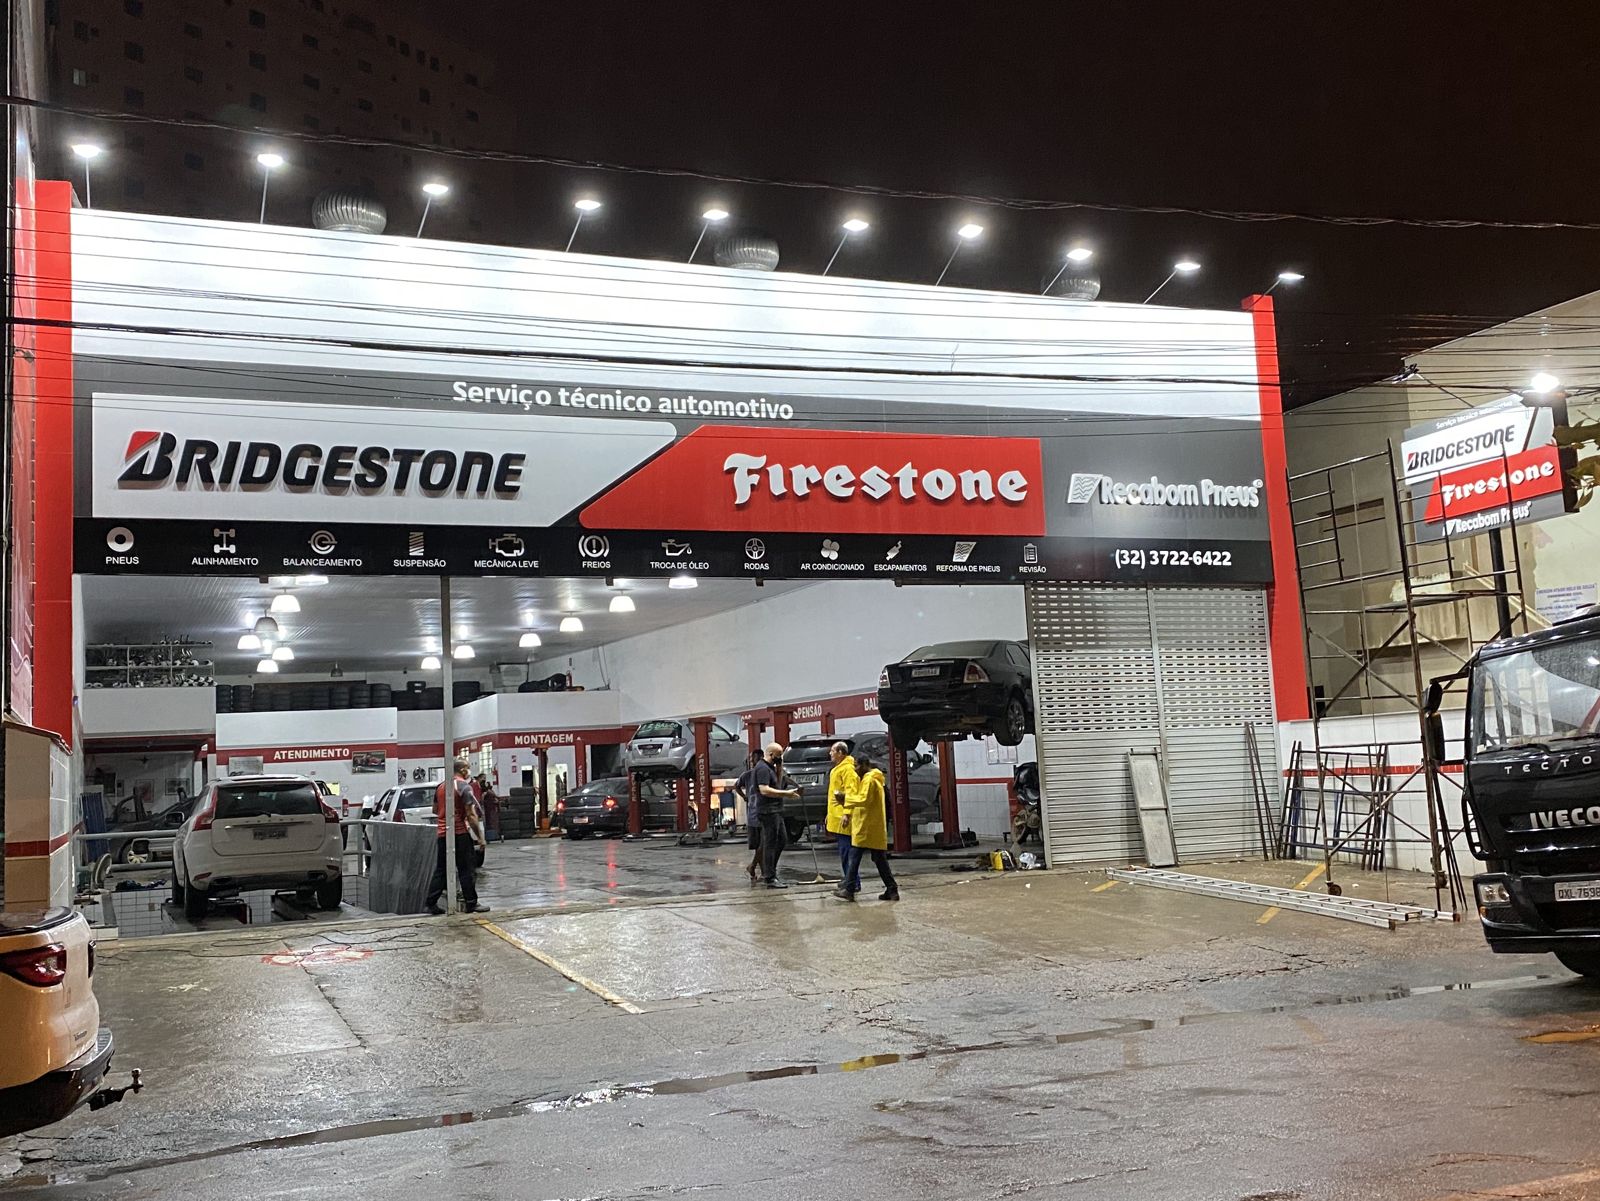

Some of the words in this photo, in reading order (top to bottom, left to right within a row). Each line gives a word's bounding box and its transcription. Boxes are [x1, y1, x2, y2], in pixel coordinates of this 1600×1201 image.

[452, 381, 552, 410] Serviço
[558, 387, 652, 413] técnico
[658, 394, 794, 420] automotivo
[1407, 425, 1515, 472] BRIDGESTONE
[117, 430, 527, 497] BRIDGESTONE
[723, 452, 1028, 505] Firestone
[1441, 461, 1555, 507] Firestone
[1100, 475, 1199, 507] Recabom
[105, 556, 140, 565] PNEUS
[191, 556, 259, 566] ALINHAMENTO
[283, 557, 363, 567] BALANCEAMENTO
[393, 557, 447, 568] SUSPENSÃO
[474, 557, 517, 568] MECÂNICA
[518, 559, 539, 568] LEVE
[582, 560, 611, 569] FREIOS
[650, 561, 676, 570] TROCA
[677, 561, 687, 570] DE
[688, 559, 710, 570] ÓLEO
[1115, 548, 1147, 570] (32)
[1149, 550, 1232, 566] 3722-6422
[744, 562, 770, 570] RODAS
[812, 563, 865, 571] CONDICIONADO
[874, 563, 927, 572] ESCAPAMENTOS
[936, 564, 968, 572] REFORMA
[979, 565, 1001, 573] PNEUS
[1019, 564, 1047, 573] REVISÃO
[514, 733, 574, 745] MONTAGEM
[273, 748, 350, 760] ATENDIMENTO
[1504, 755, 1593, 774] TECTO
[1529, 806, 1600, 829] IVECO
